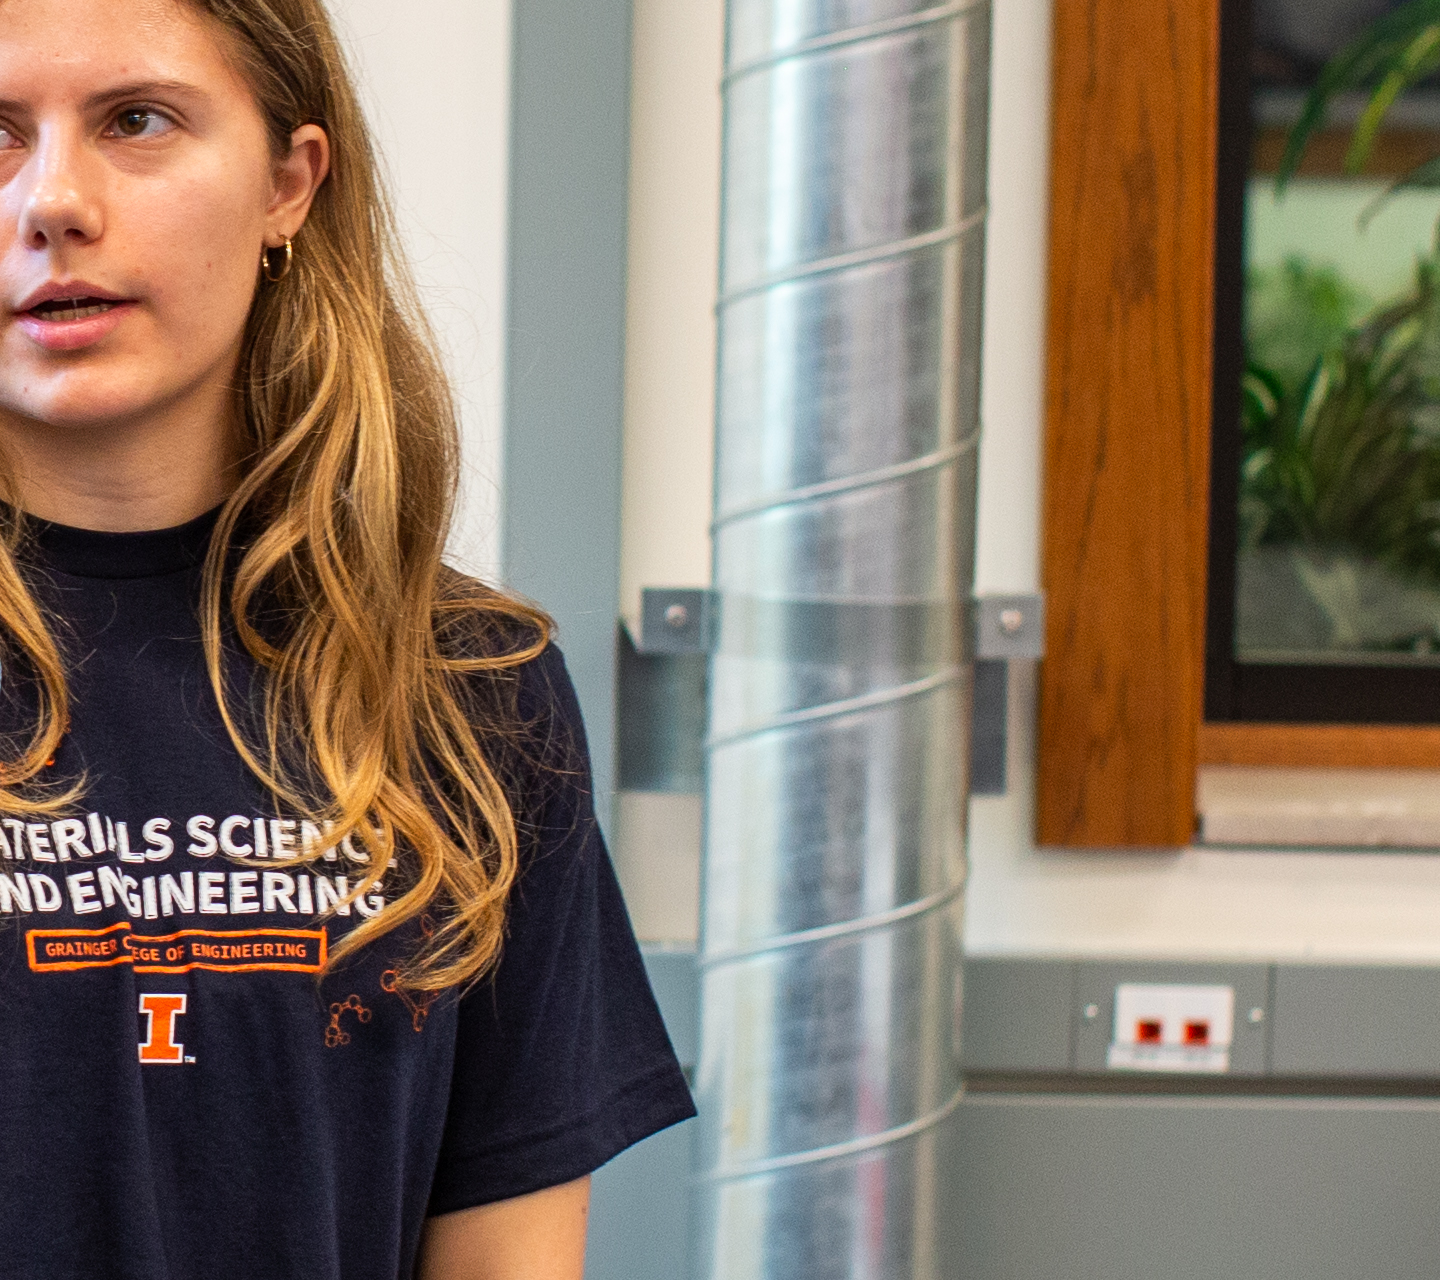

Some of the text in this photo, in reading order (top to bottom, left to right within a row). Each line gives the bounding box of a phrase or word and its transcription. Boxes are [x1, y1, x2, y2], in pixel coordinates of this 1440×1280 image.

[45, 938, 117, 957] GRAINGER
[165, 944, 184, 961] OF
[191, 942, 307, 960] ENGINEERING
[138, 993, 187, 1063] I
